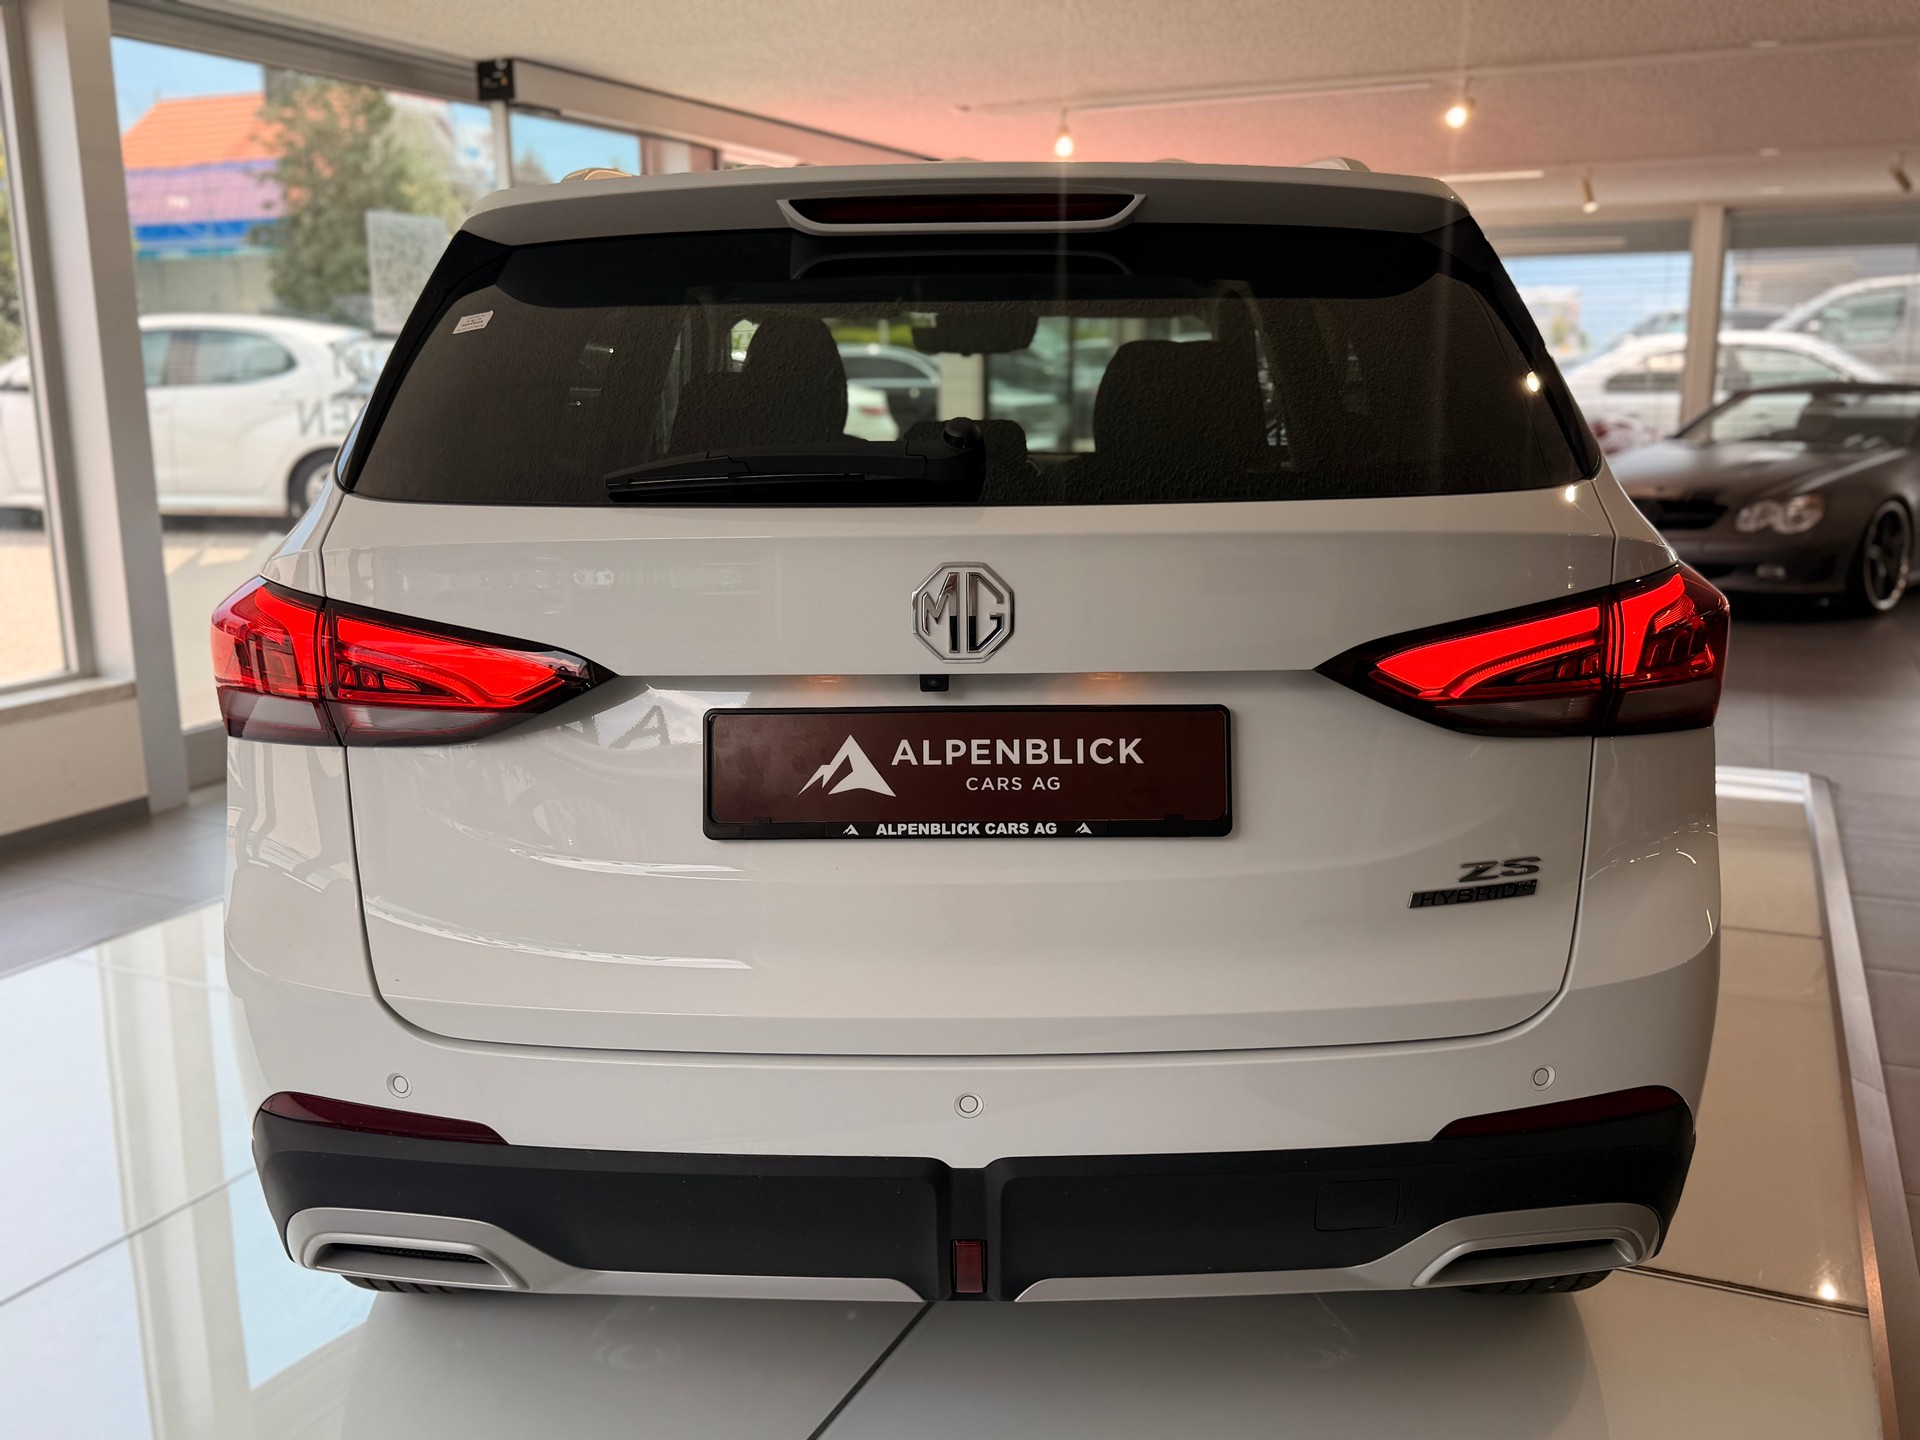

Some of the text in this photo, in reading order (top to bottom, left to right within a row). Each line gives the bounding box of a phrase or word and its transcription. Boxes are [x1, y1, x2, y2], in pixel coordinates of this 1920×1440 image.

[922, 571, 1004, 654] MG
[891, 737, 1144, 765] ALPENBLICK
[965, 776, 1061, 791] CARS AG
[876, 822, 1057, 836] ALPENBLICK CARS AG
[1457, 856, 1541, 881] ZS
